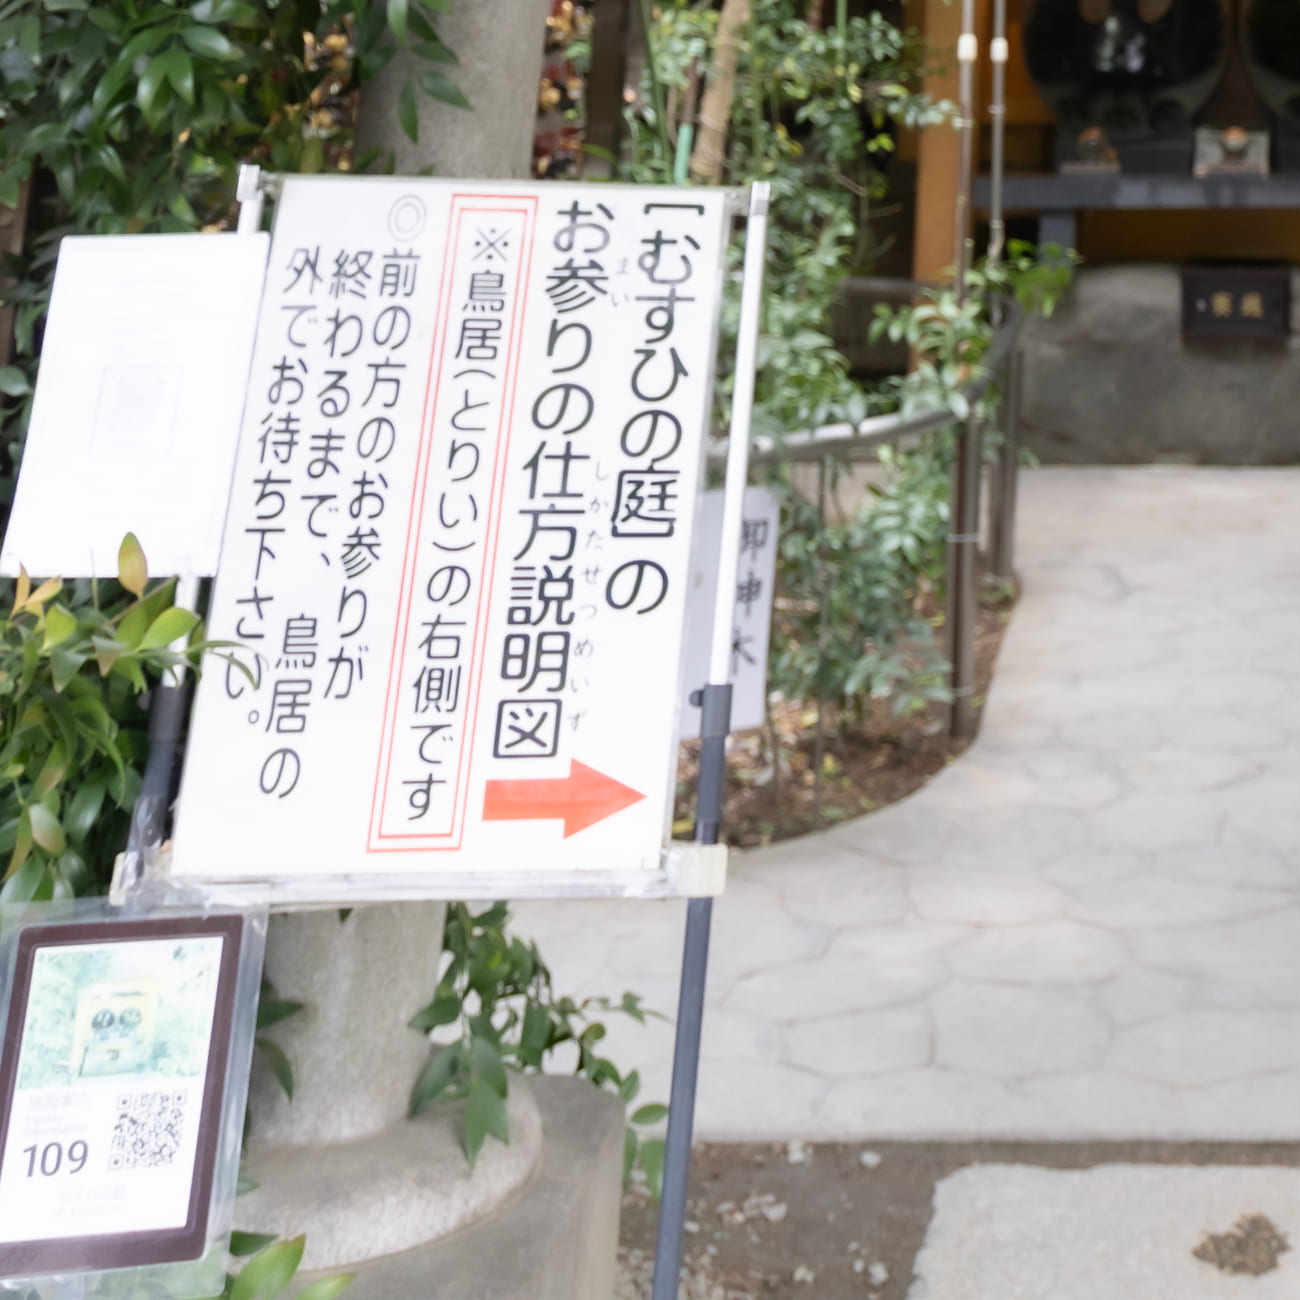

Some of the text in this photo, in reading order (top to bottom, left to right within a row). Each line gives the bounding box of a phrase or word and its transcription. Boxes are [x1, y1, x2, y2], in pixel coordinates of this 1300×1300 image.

[493, 200, 615, 759] お参りの仕方説明図
[259, 613, 319, 799] 鳥居の
[22, 1139, 89, 1178] 109
